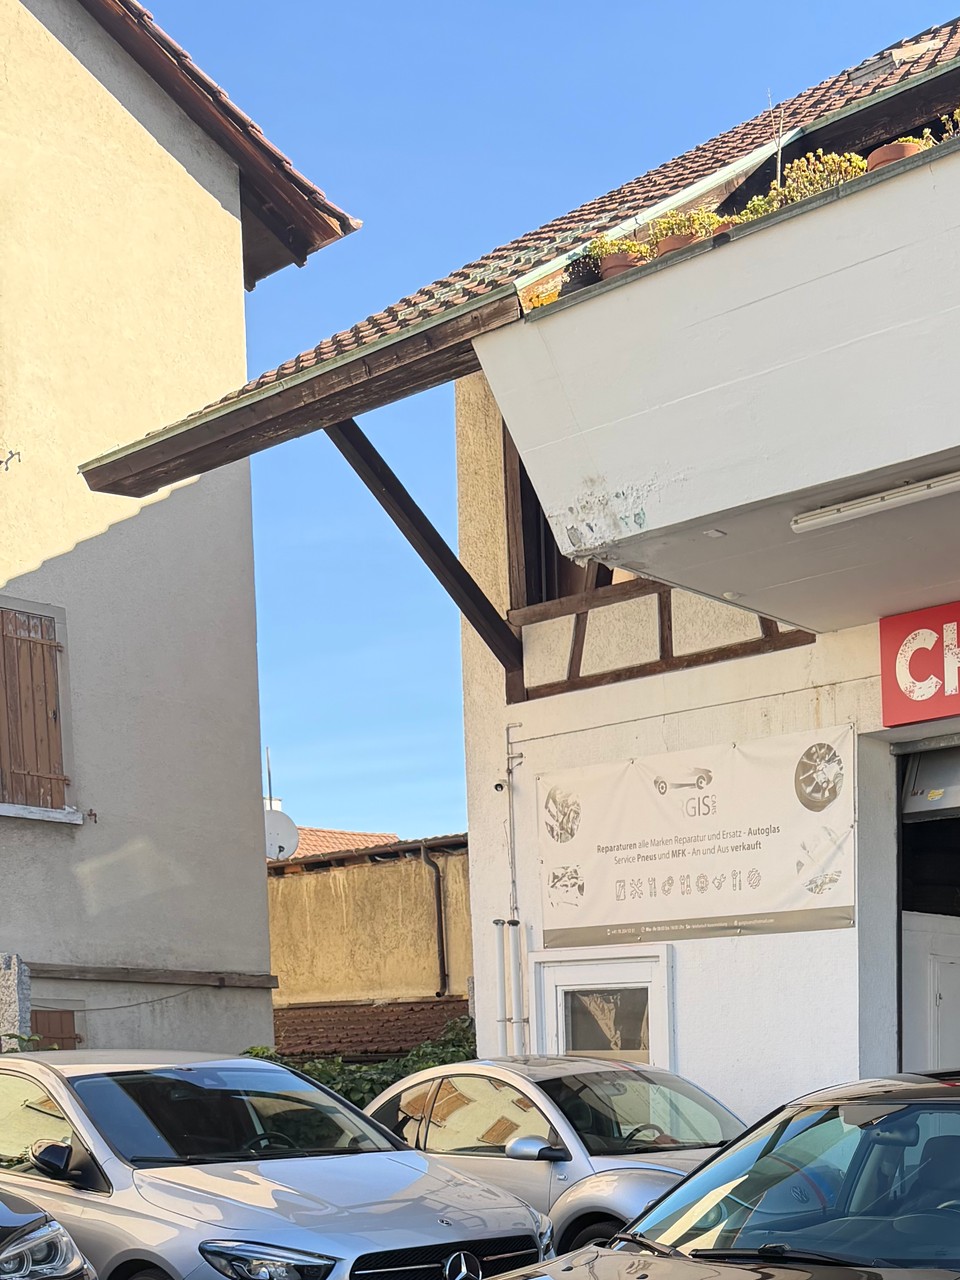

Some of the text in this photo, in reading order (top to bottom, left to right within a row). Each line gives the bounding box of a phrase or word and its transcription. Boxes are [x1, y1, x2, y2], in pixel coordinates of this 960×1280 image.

[596, 842, 637, 854] Reparaturen
[638, 839, 650, 849] alle
[650, 837, 673, 847] Marken
[674, 834, 706, 846] Reparatur
[707, 831, 721, 841] und
[722, 829, 742, 839] Ersatz
[747, 824, 780, 836] Autoglas
[614, 854, 636, 864] Service
[637, 852, 657, 862] Pneus
[658, 850, 670, 860] und
[671, 849, 687, 859] MFK
[691, 847, 701, 856] An
[702, 845, 716, 855] und
[717, 844, 730, 854] Aus
[730, 840, 762, 852] verkauft
